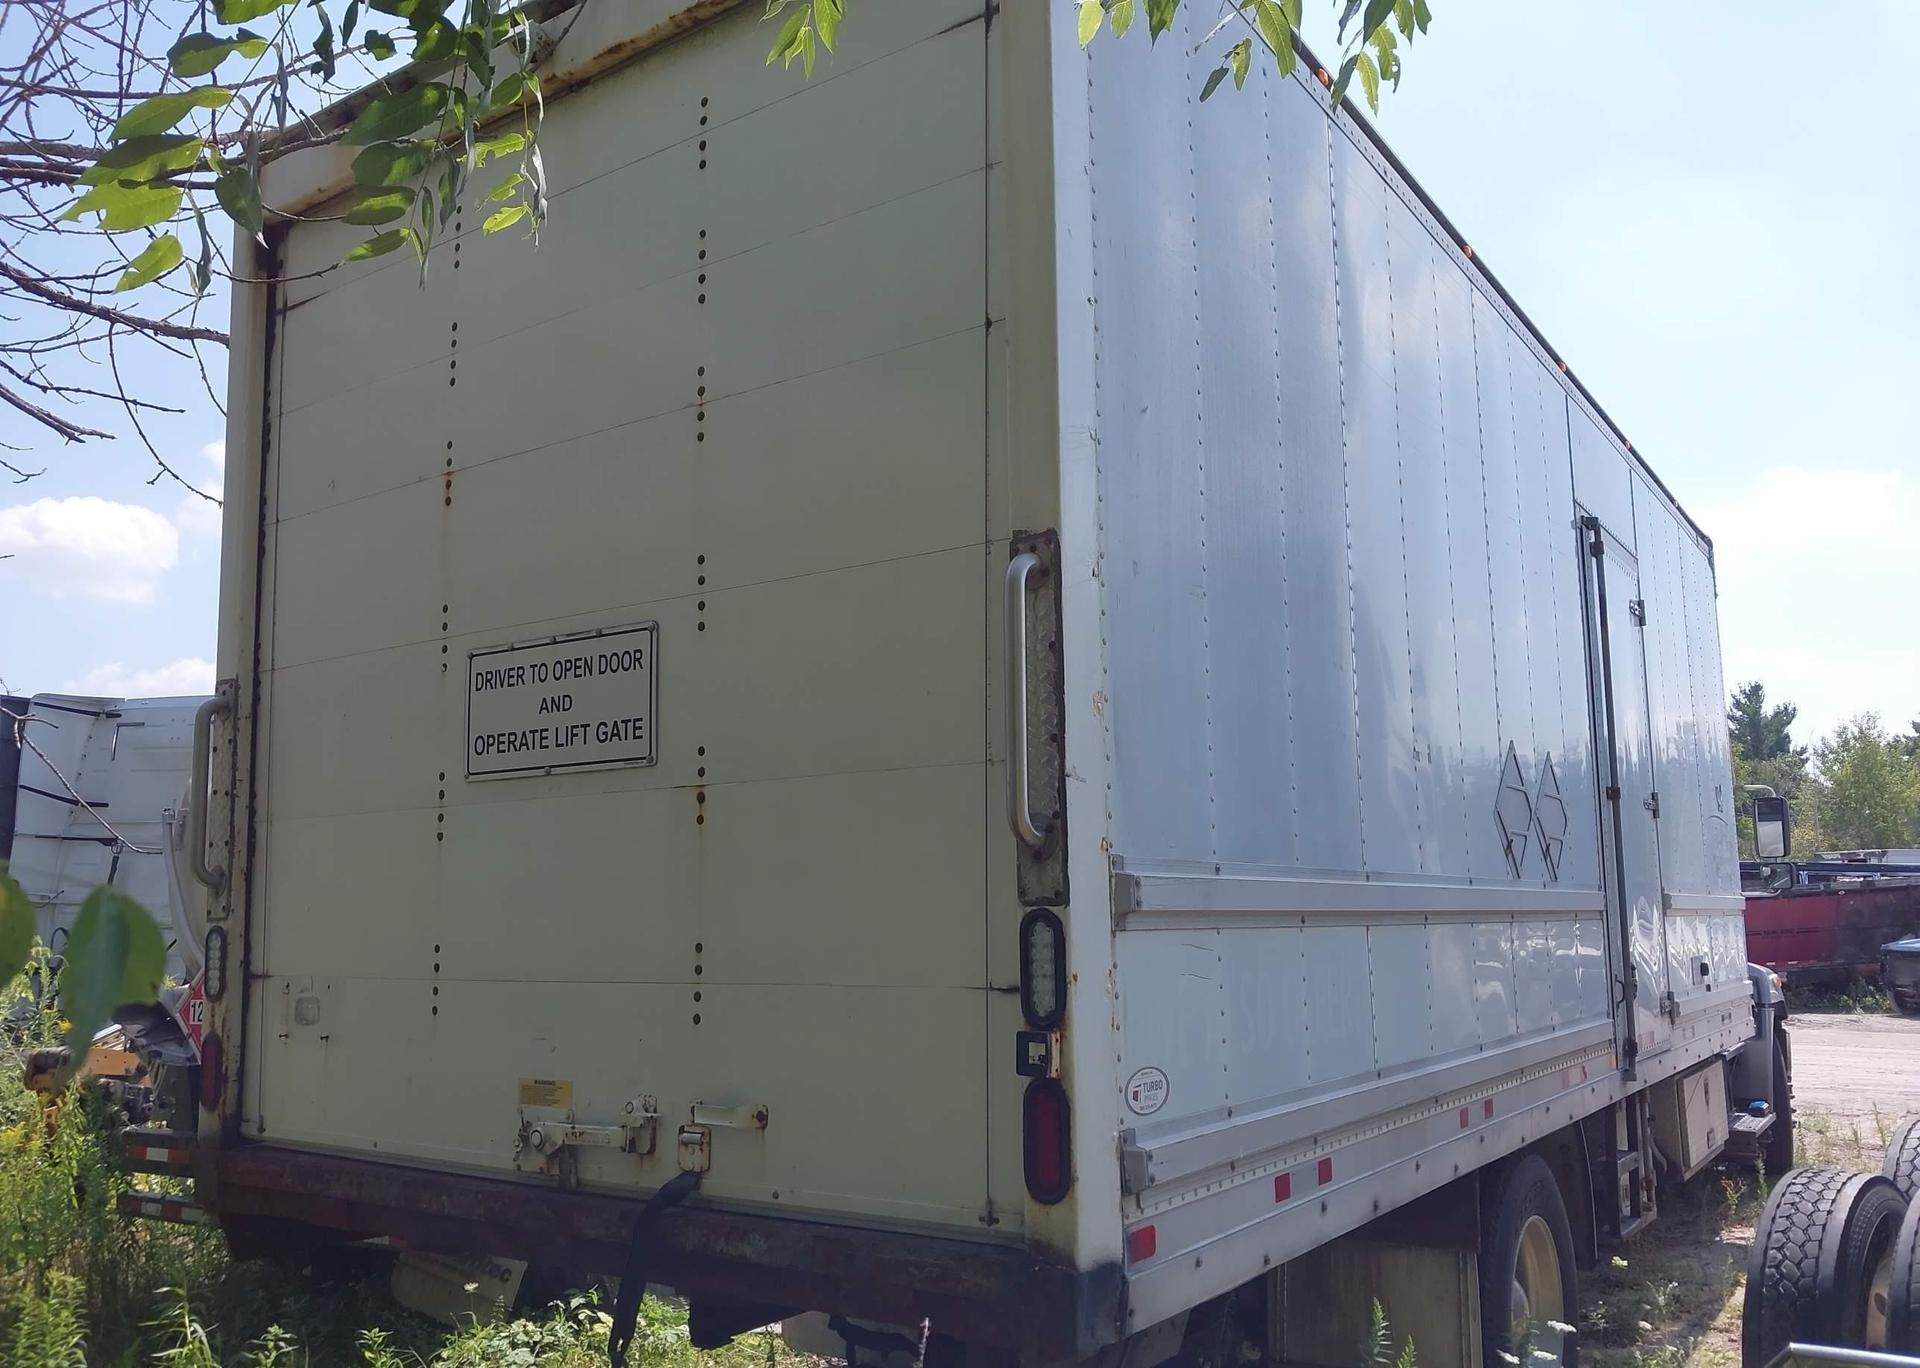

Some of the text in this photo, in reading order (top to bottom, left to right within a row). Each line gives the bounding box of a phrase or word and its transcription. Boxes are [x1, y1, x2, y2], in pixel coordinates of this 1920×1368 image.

[475, 649, 644, 691] DRIVER TO OPEN DOOR
[539, 694, 573, 715] AND
[474, 717, 644, 756] OPERATE LIFT GATE
[1142, 1079, 1163, 1094] TURBO
